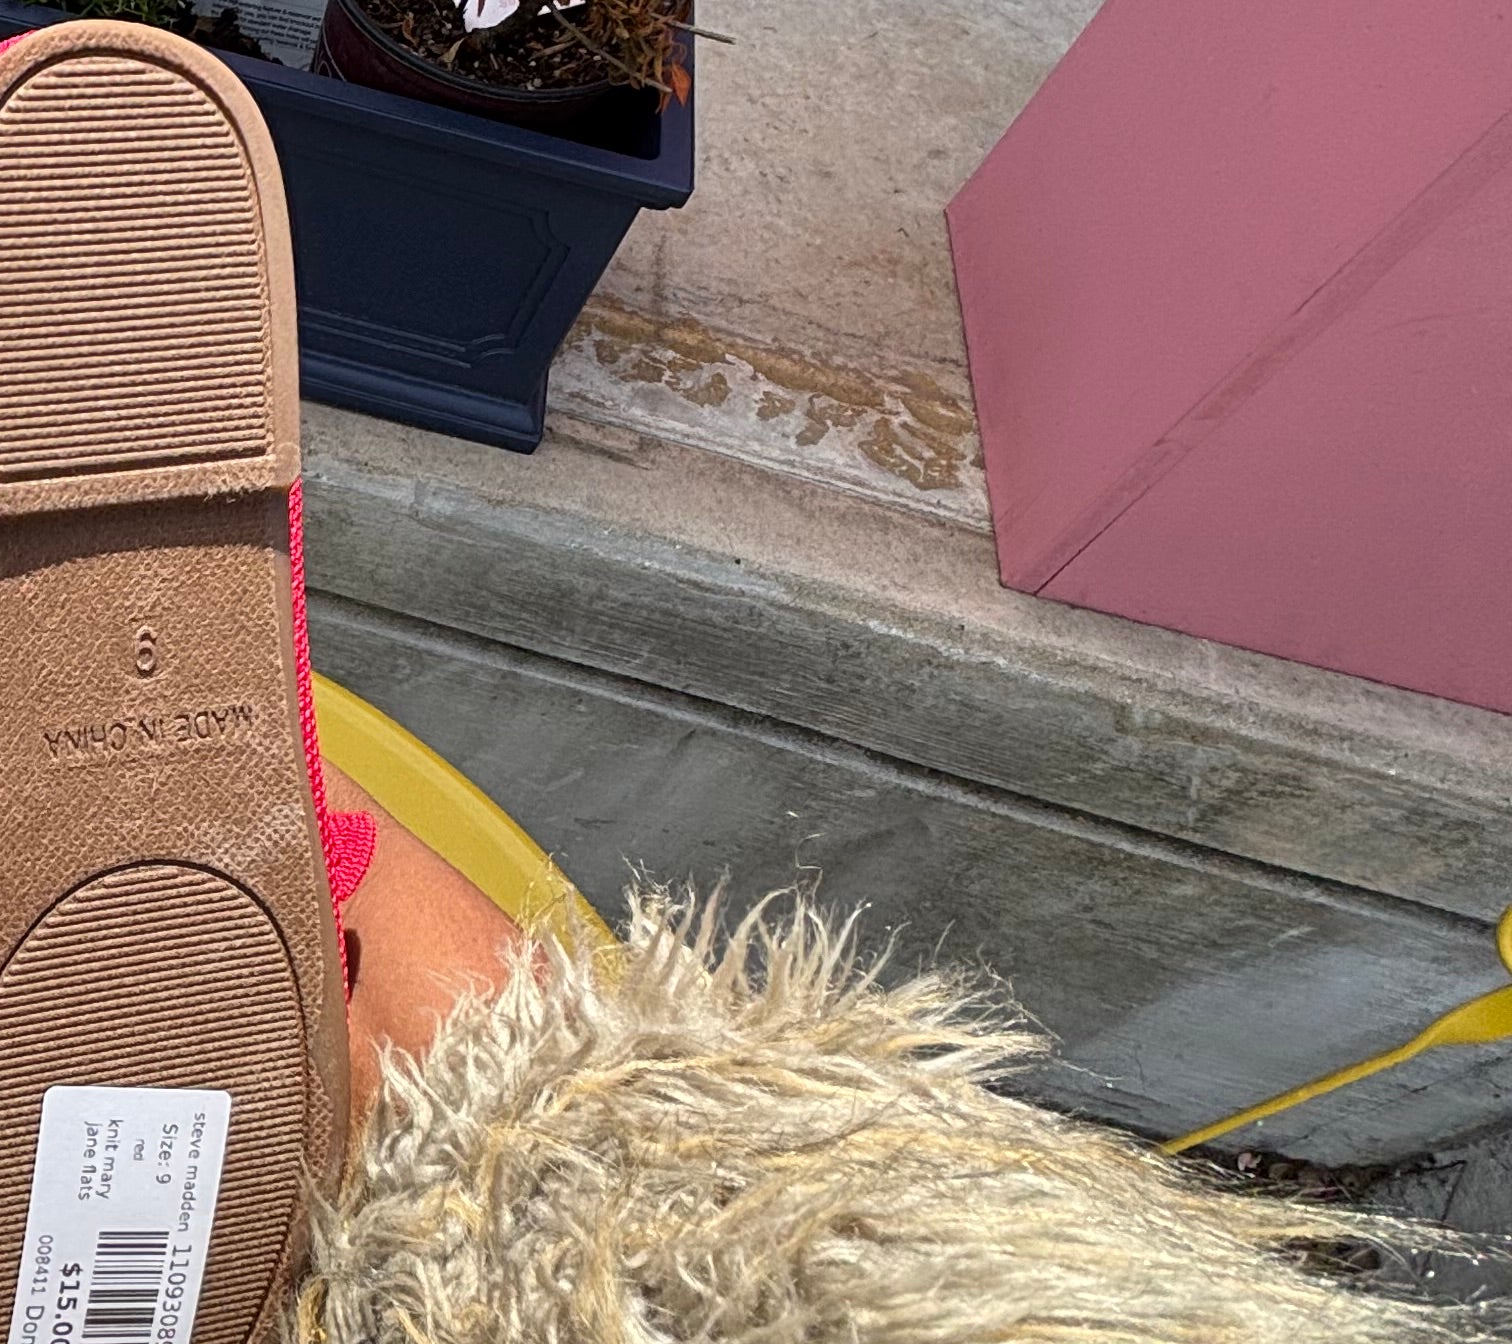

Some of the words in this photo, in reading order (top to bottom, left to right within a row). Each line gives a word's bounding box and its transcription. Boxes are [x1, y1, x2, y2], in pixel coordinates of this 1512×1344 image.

[43, 721, 128, 756] CHINA
[139, 717, 166, 741] IN
[175, 704, 253, 743] MADE
[85, 1121, 103, 1157] jane
[105, 1119, 124, 1151] knit
[133, 1139, 146, 1162] red
[157, 1124, 179, 1167] Size:
[188, 1112, 206, 1159] steve
[78, 1164, 97, 1201] flats
[95, 1156, 115, 1200] mary
[156, 1174, 172, 1185] 9
[177, 1166, 198, 1232] madden
[30, 1235, 54, 1296] 008411
